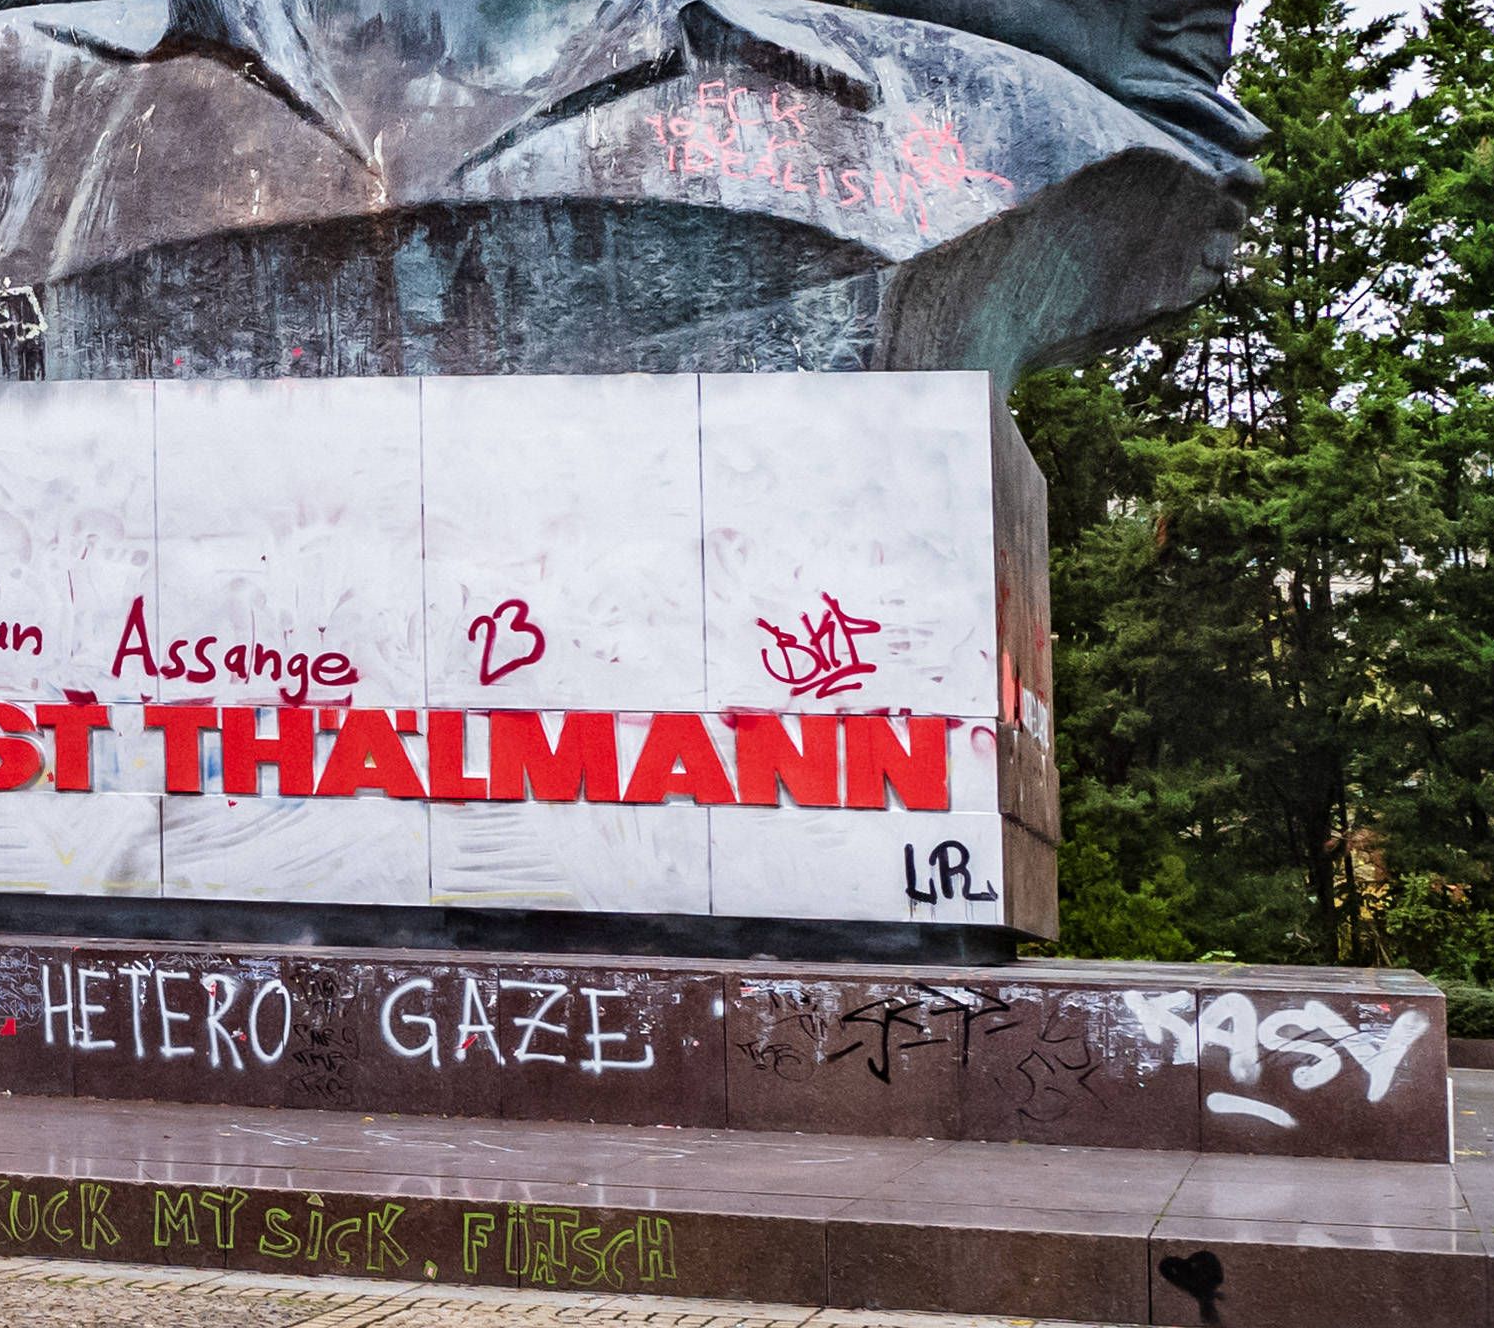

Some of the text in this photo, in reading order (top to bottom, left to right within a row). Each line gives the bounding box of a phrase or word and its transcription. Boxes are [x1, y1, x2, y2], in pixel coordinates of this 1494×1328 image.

[696, 80, 806, 135] FCK
[668, 138, 929, 233] IDEALISM
[111, 595, 361, 708] Assange
[468, 598, 546, 686] 23
[143, 703, 951, 811] THÄLMANN
[41, 960, 293, 1071] HETERO
[379, 976, 655, 1074] GAZE
[154, 1187, 250, 1249] MY
